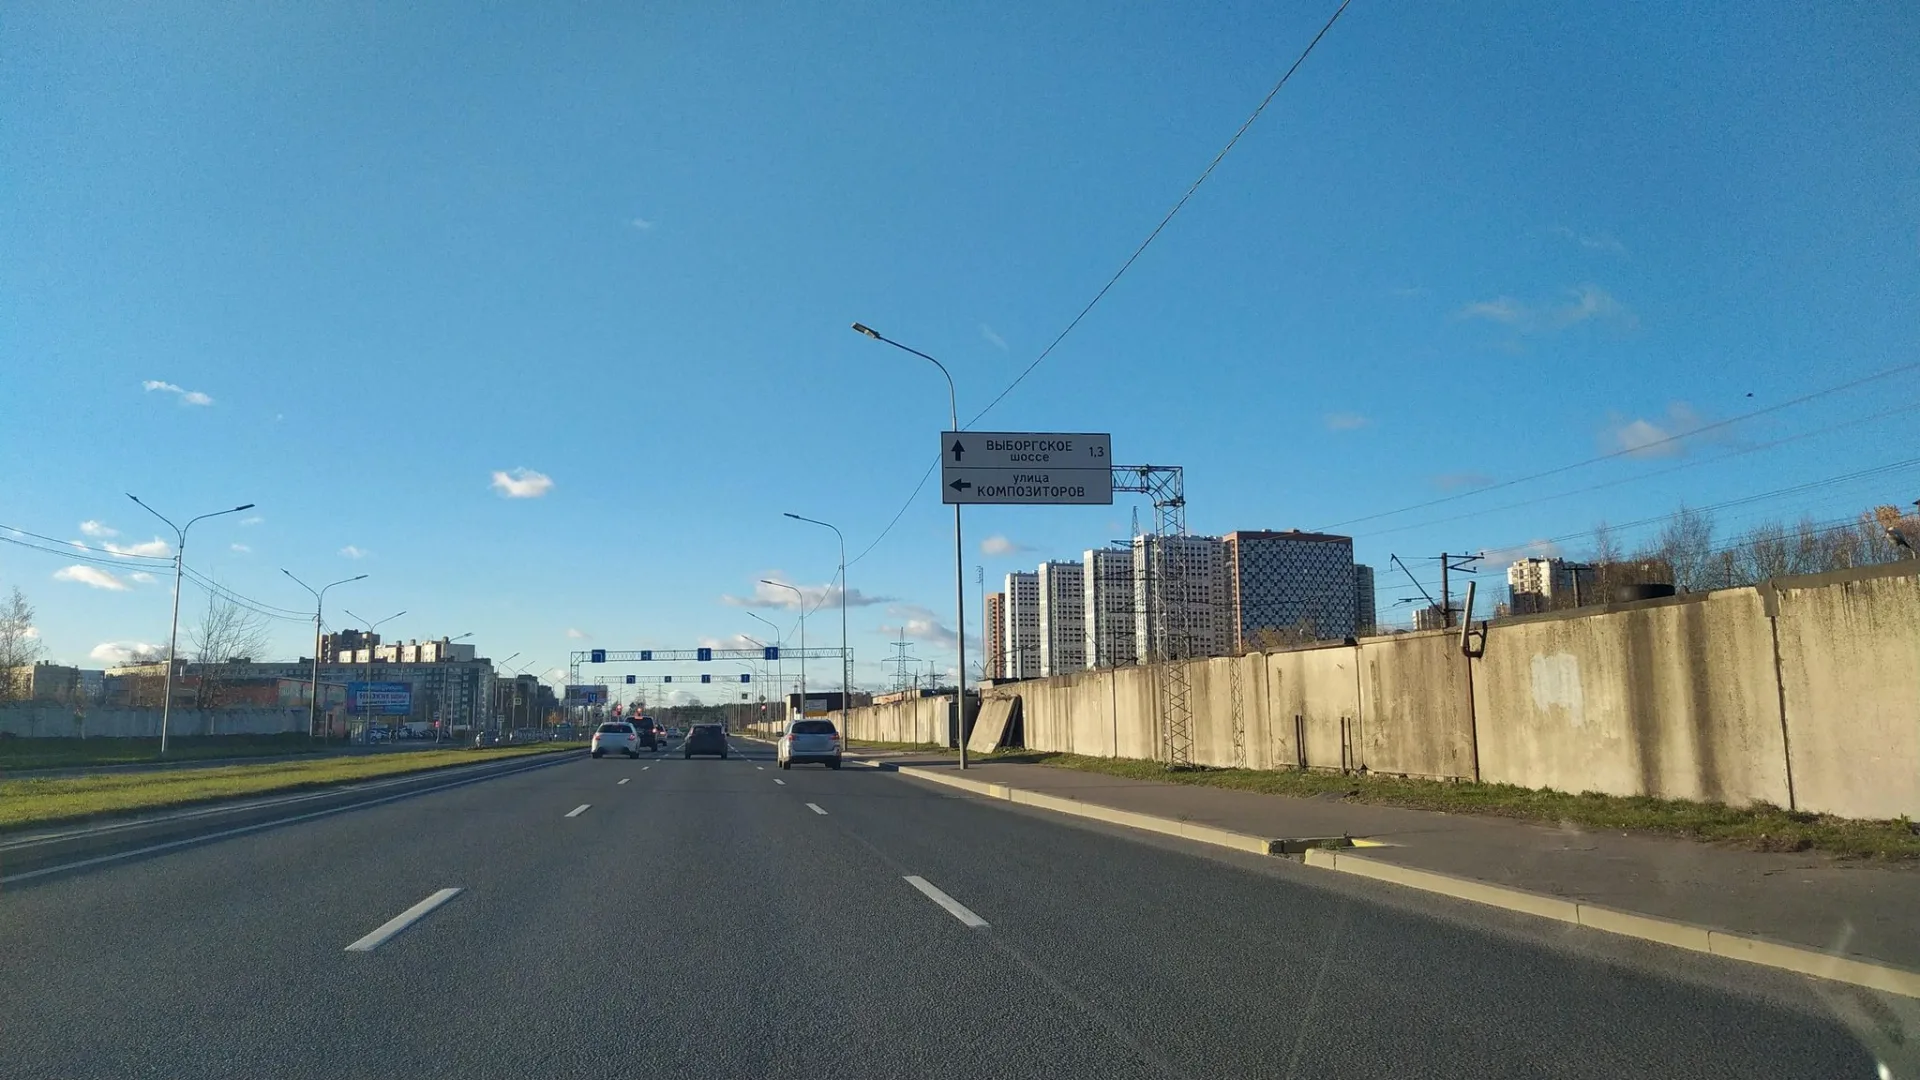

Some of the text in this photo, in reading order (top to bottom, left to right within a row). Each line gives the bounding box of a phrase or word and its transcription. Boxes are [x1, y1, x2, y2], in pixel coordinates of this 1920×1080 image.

[986, 440, 1073, 452] ВЫБОРГСКОЕ
[1010, 452, 1050, 462] шоссе
[1088, 447, 1105, 458] 1,3
[1013, 474, 1050, 485] улица
[977, 486, 1086, 498] КОМПОЗИТОРОВ
